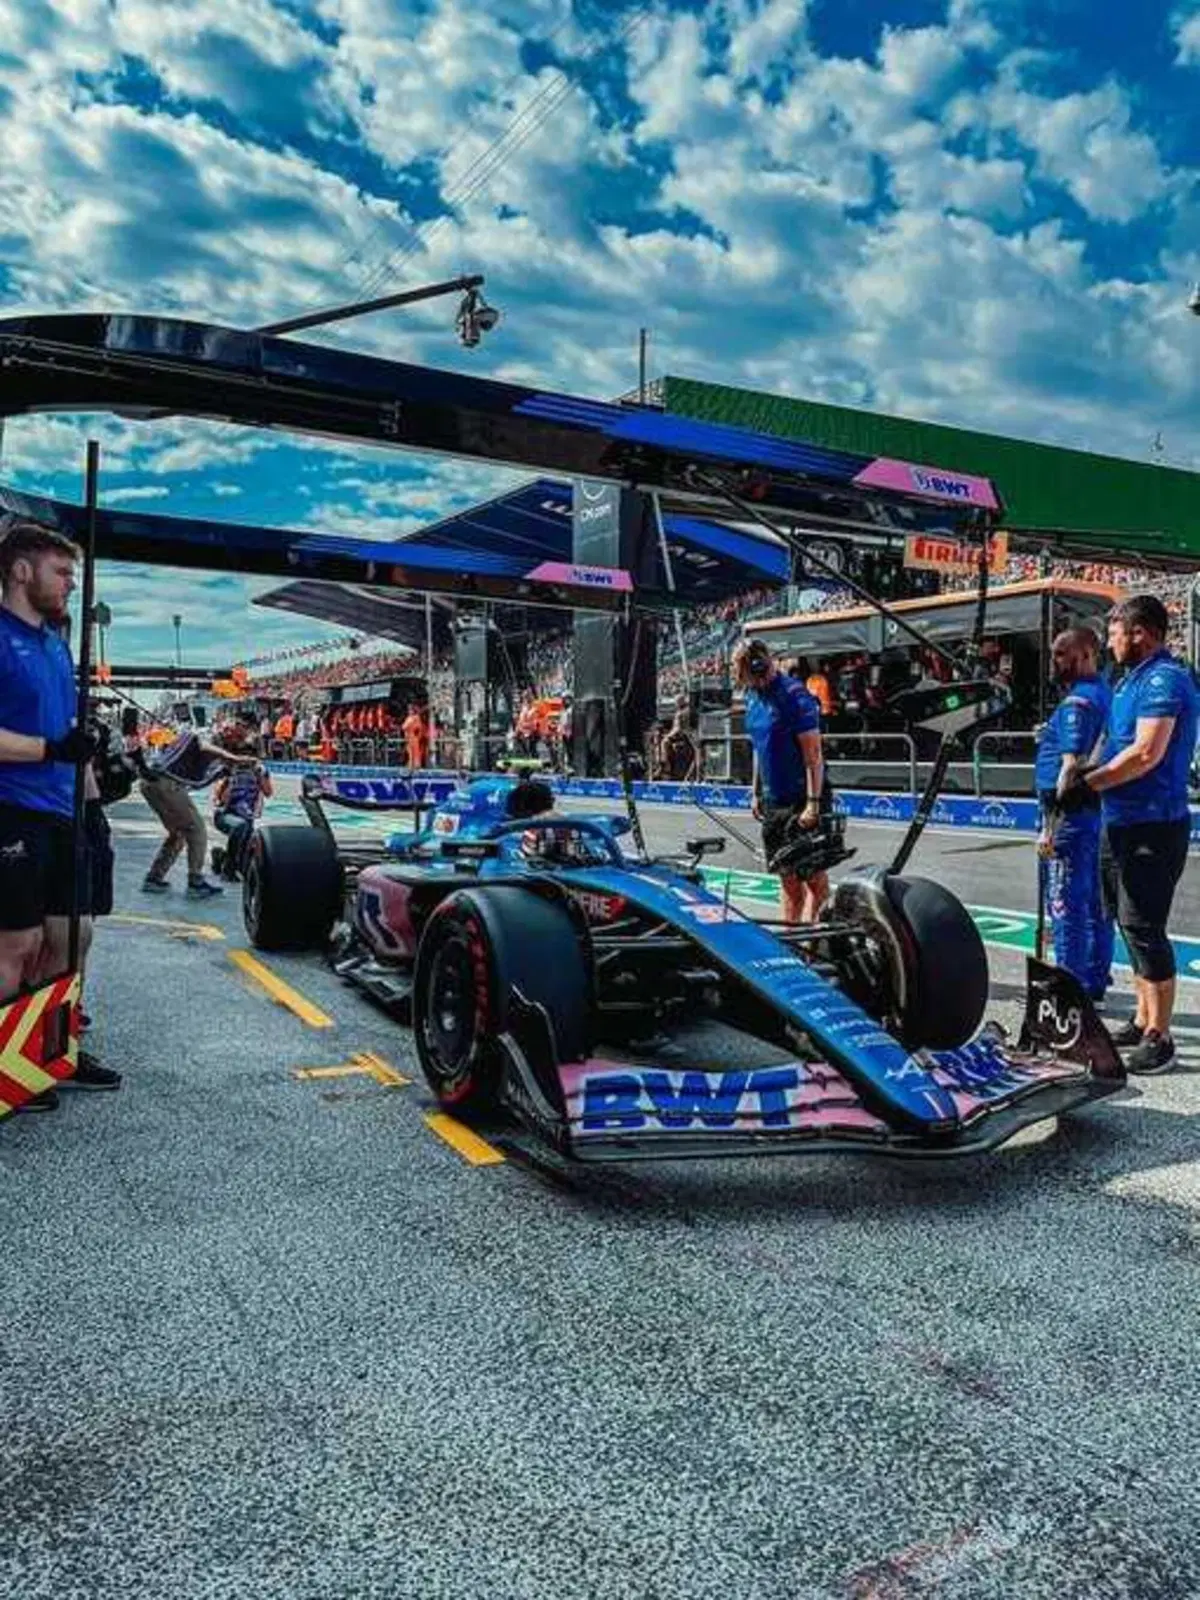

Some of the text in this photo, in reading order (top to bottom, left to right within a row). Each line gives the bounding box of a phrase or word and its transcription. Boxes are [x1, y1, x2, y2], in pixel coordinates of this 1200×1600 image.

[930, 476, 970, 497] BWT
[1037, 997, 1082, 1050] plug
[582, 1067, 799, 1131] BWT
